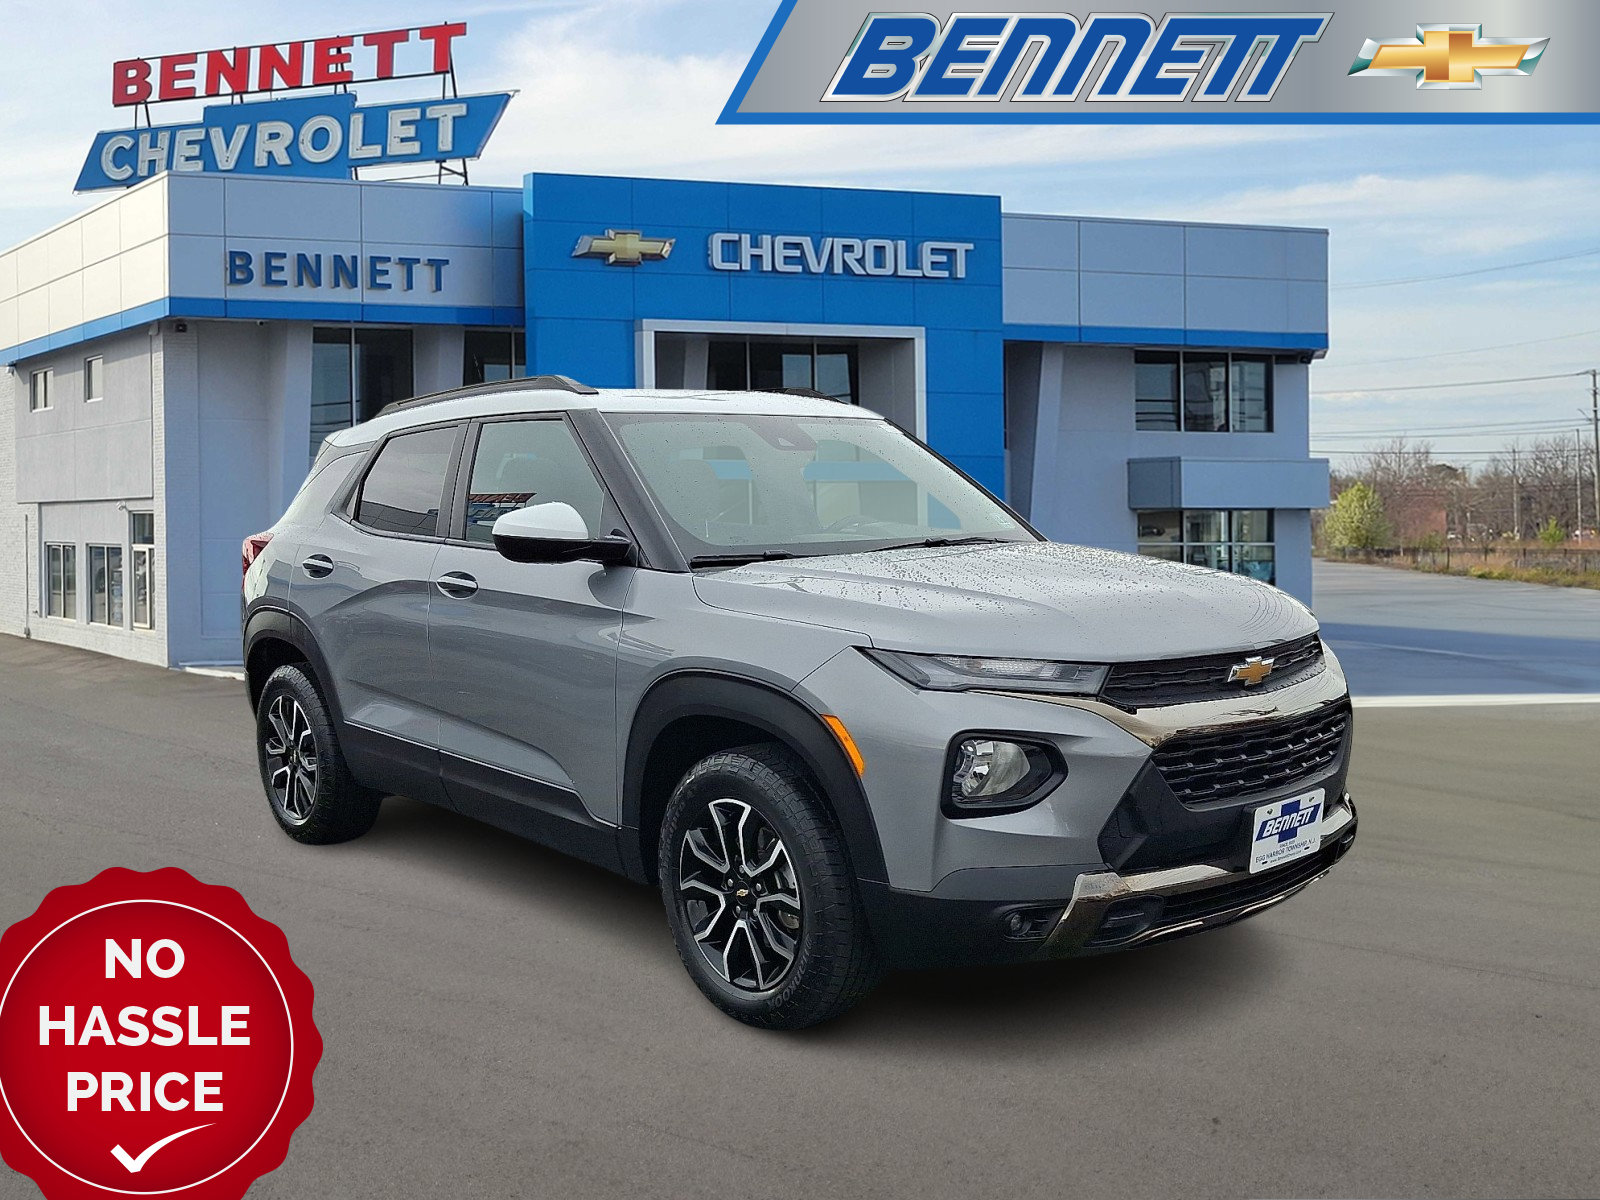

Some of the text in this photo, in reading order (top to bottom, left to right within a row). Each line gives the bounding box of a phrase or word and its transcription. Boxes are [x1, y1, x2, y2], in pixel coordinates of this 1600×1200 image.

[112, 22, 467, 107] BENNETT
[100, 103, 468, 181] CHEVROLET
[227, 249, 450, 293] BENNETT
[708, 232, 975, 279] CHEVROLET
[1263, 808, 1314, 836] BENNETT
[1266, 848, 1285, 858] HARBOR
